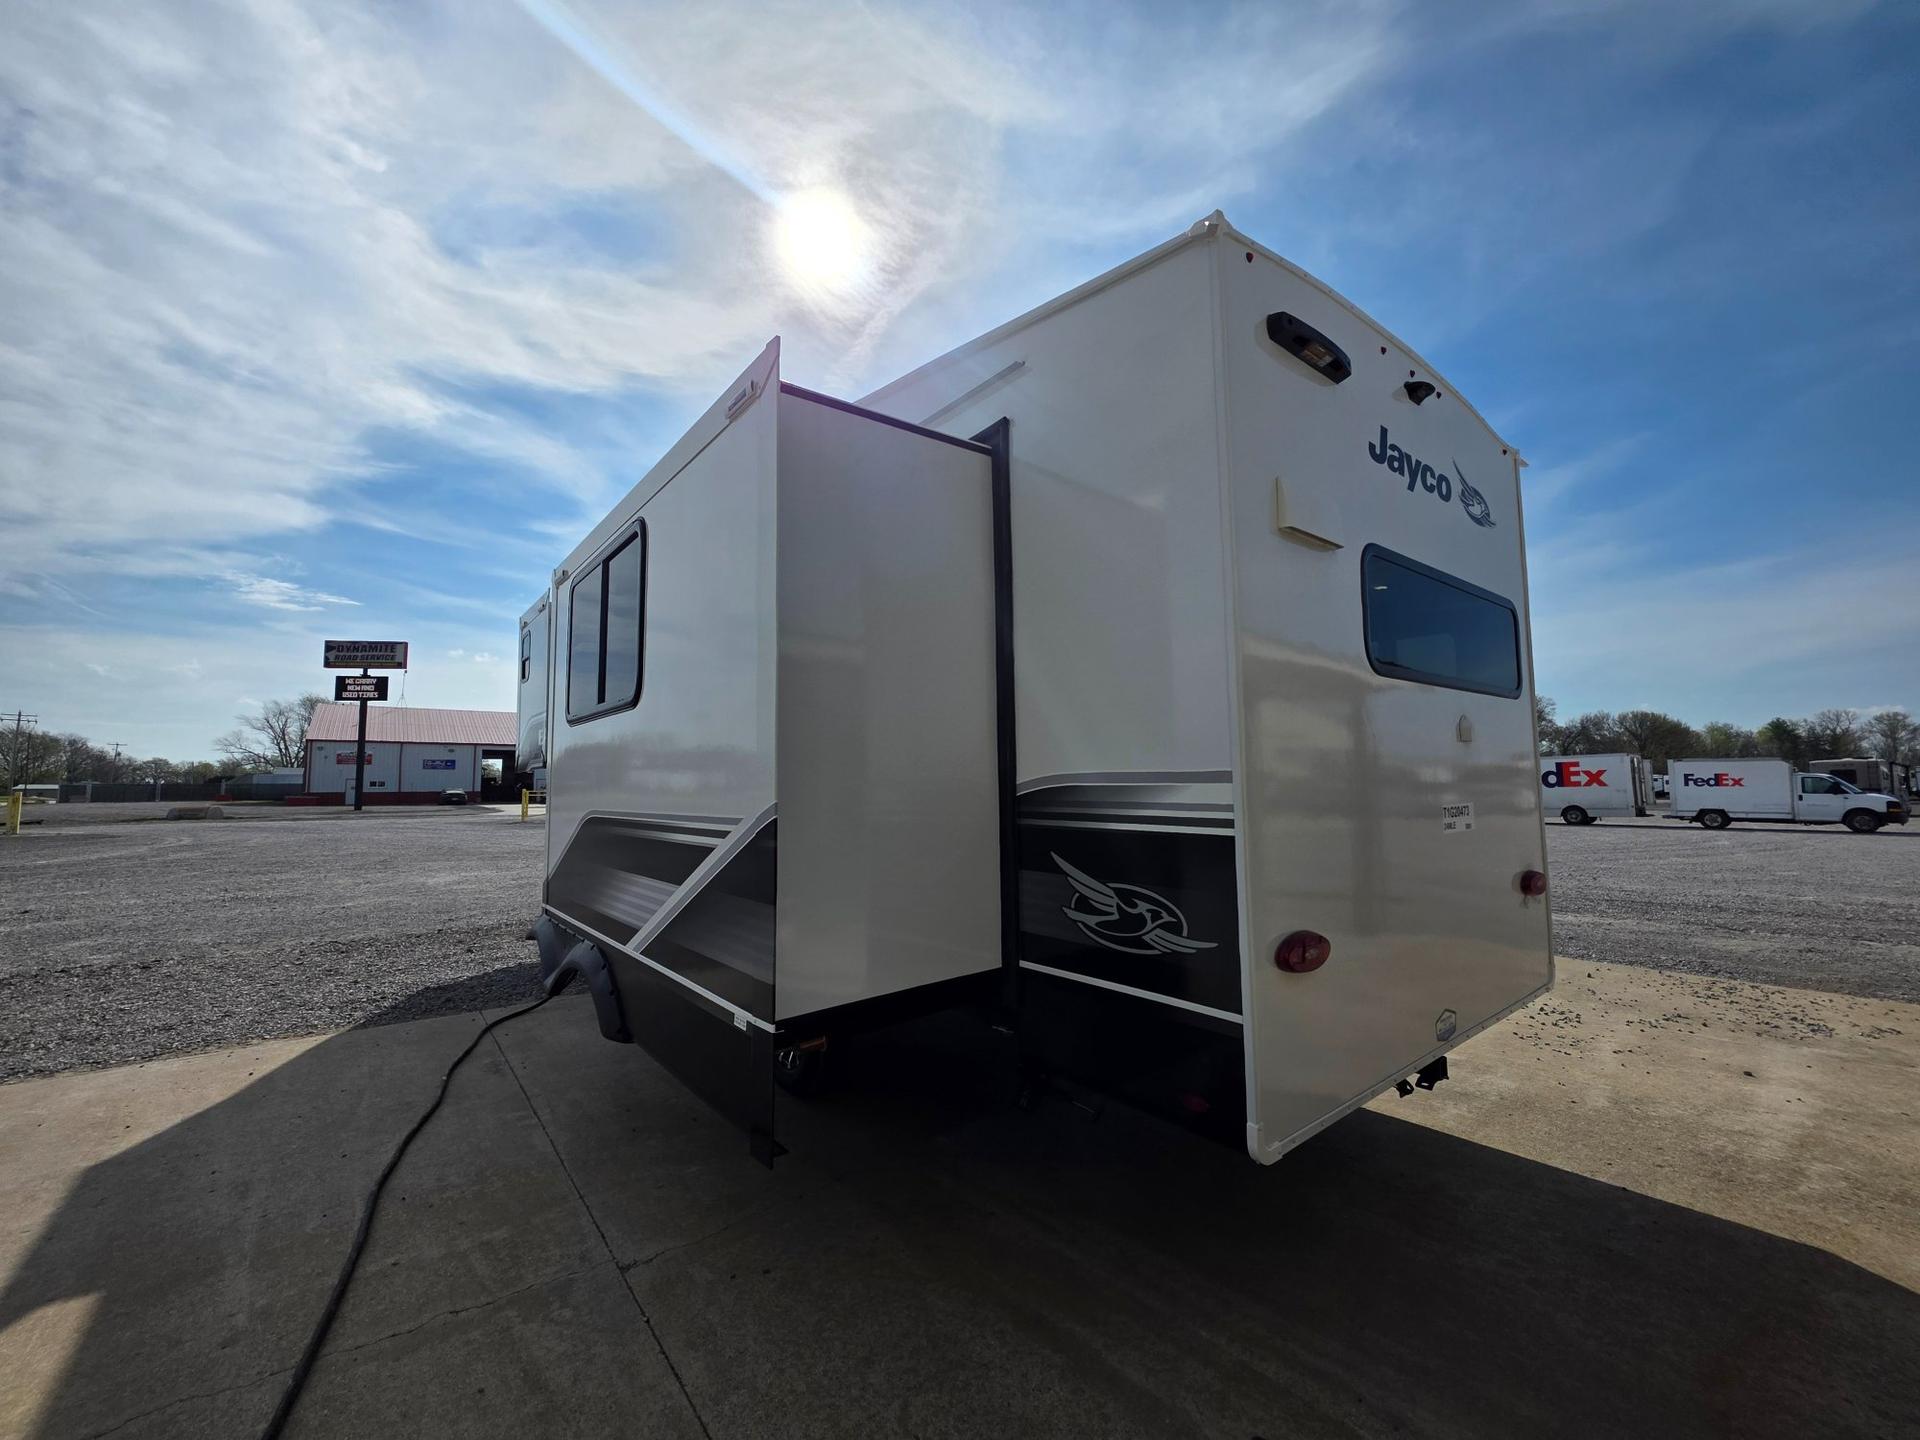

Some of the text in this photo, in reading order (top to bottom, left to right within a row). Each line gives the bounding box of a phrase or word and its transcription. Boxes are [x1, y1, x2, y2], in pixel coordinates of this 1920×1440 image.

[1368, 424, 1452, 503] Jayco
[336, 644, 397, 653] DYNAMITE
[1541, 761, 1608, 788] dEx
[1683, 773, 1745, 787] FedEx
